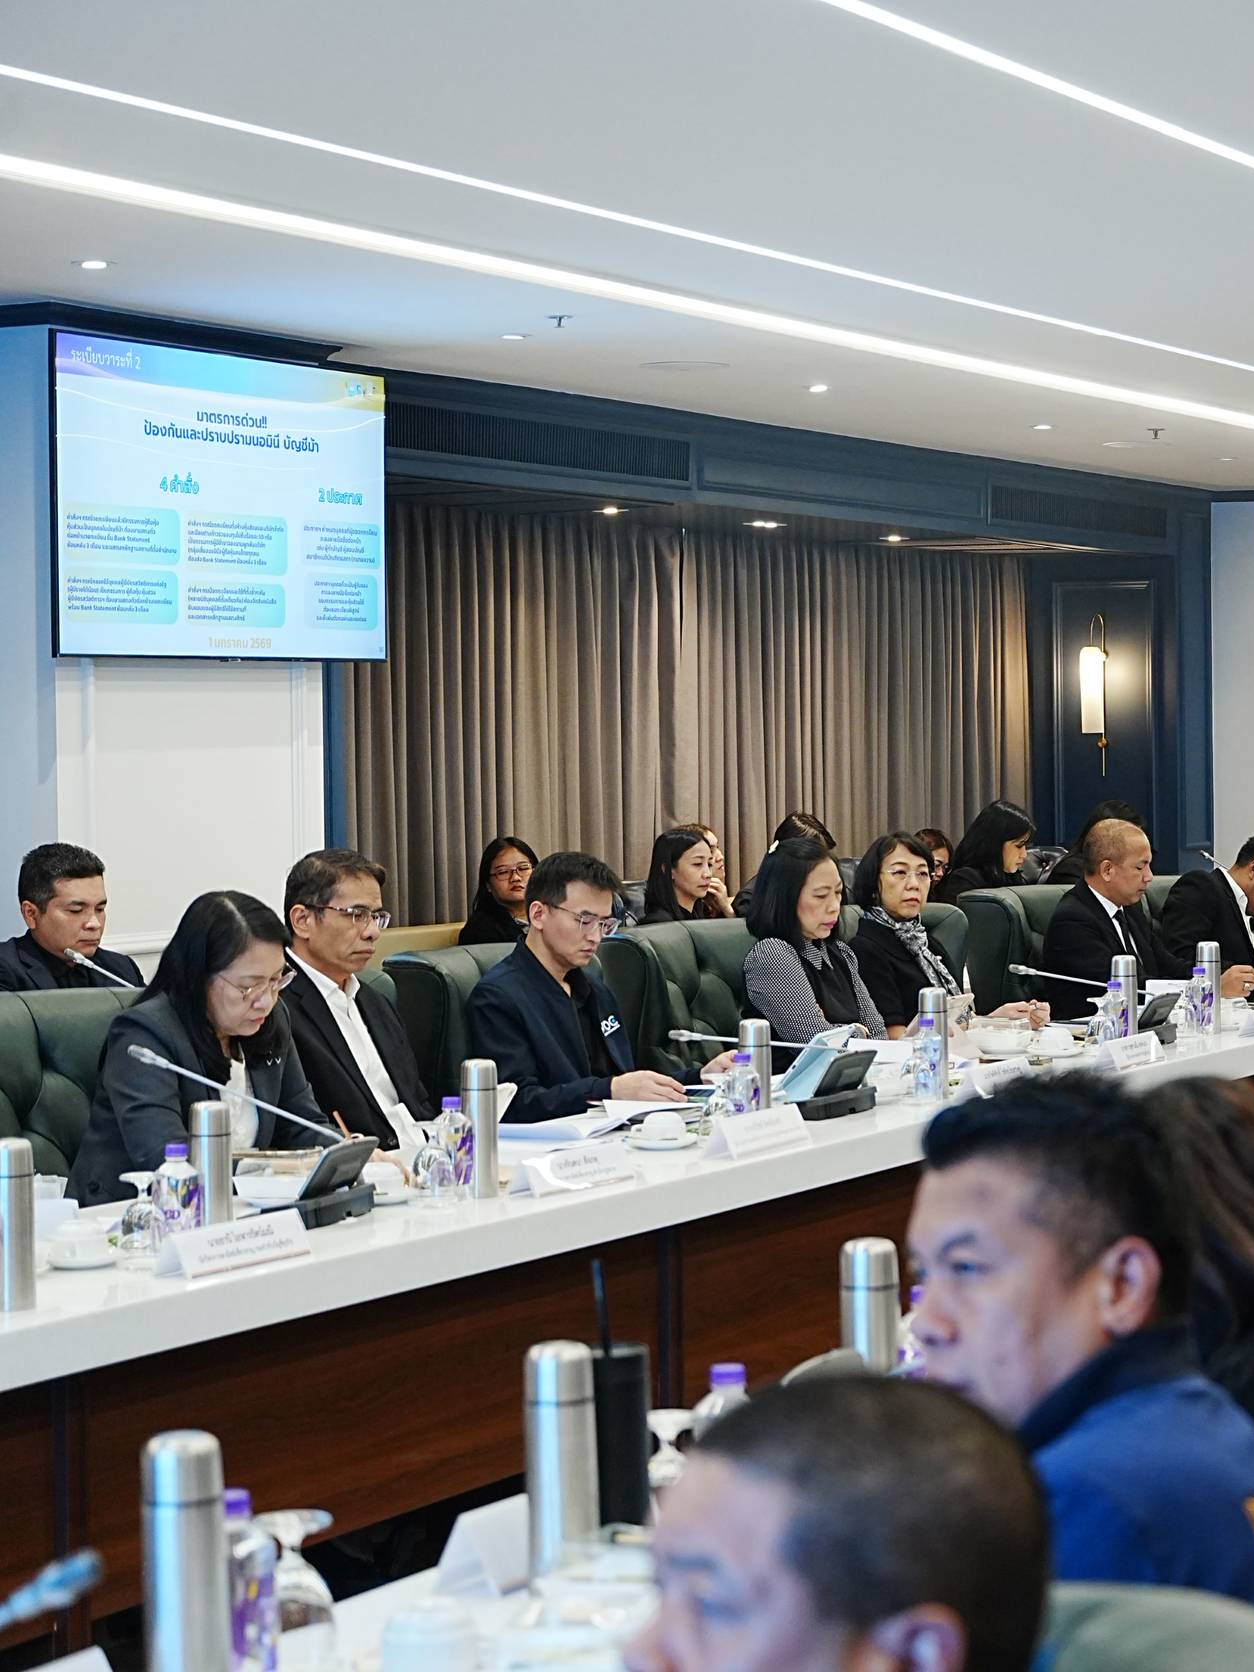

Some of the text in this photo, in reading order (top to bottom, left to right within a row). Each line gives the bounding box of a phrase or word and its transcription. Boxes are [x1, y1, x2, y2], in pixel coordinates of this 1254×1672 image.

[135, 356, 142, 370] 2
[196, 411, 268, 429] มาตรการด่วน!!
[144, 419, 319, 453] ป้องกันและปราบปรามนอมินี บัญชีม้า
